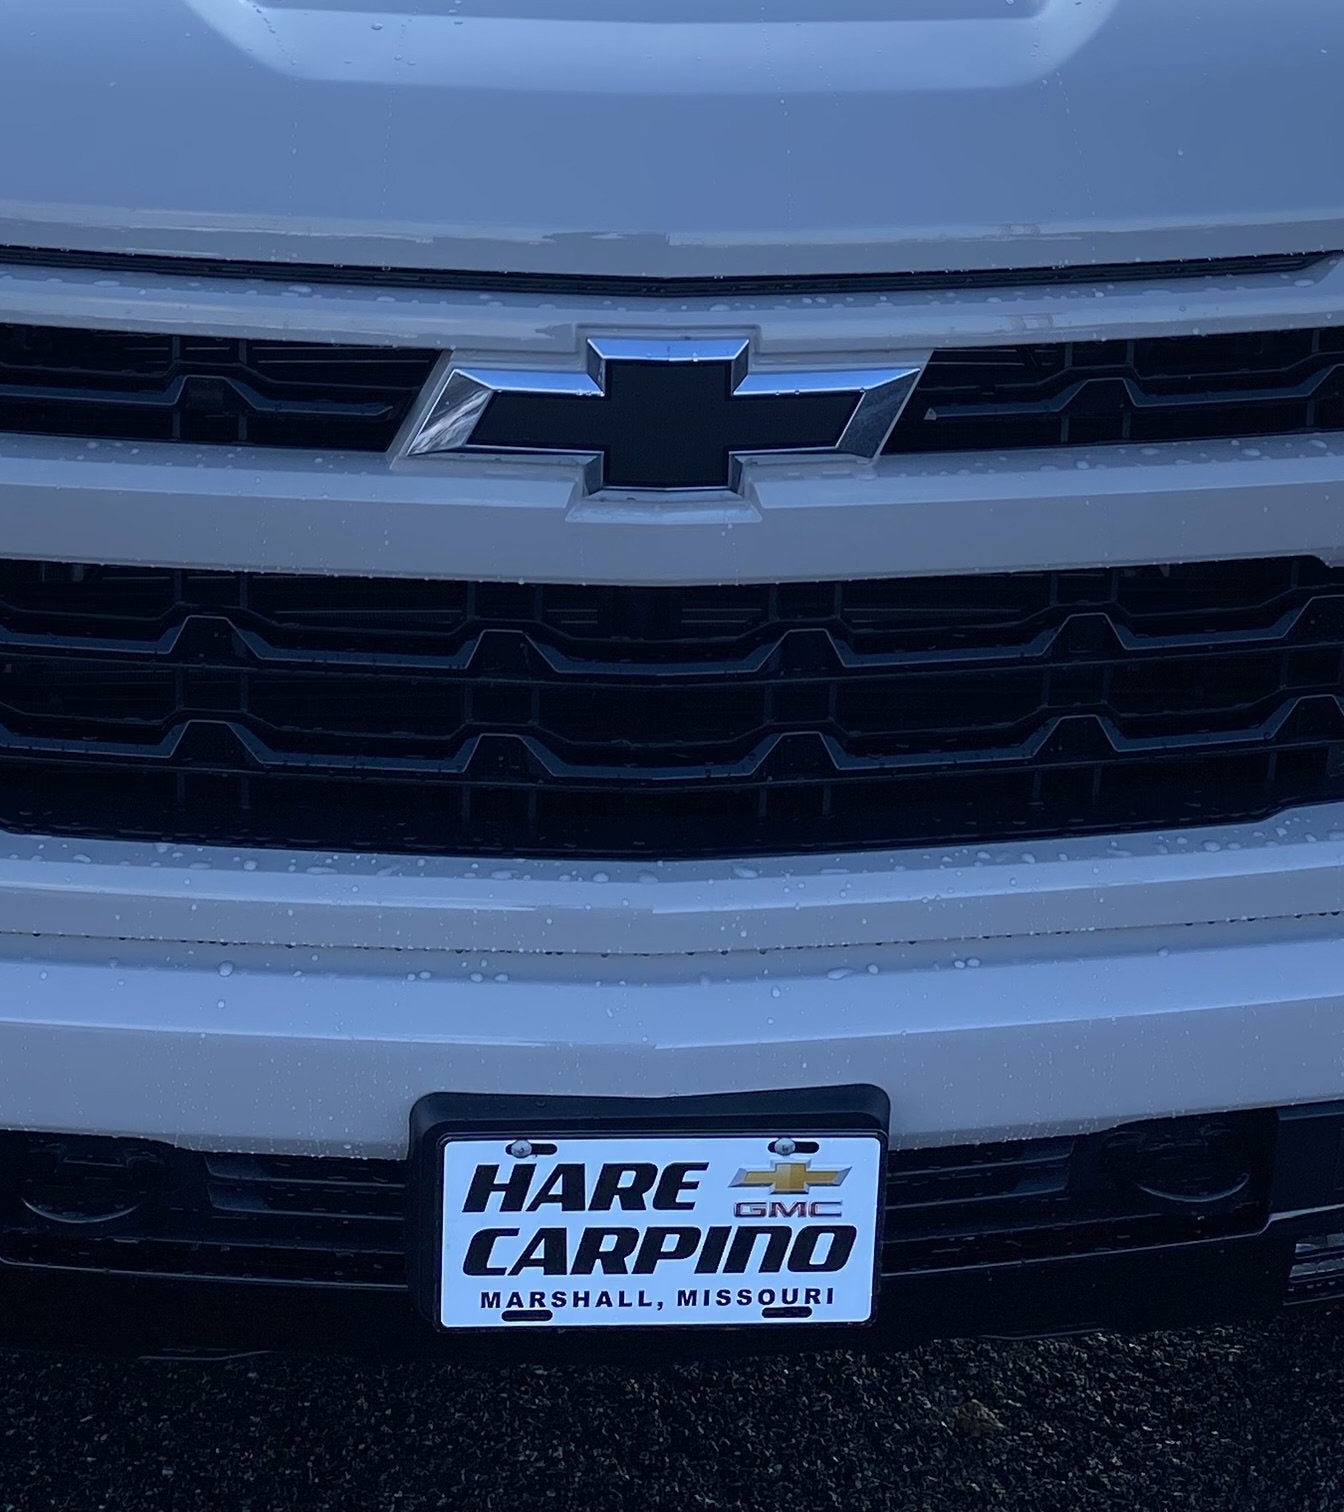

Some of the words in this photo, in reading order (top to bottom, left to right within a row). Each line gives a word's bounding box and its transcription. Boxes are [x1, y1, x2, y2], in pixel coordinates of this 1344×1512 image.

[462, 1162, 709, 1213] HARE
[733, 1199, 844, 1218] GMC
[462, 1225, 858, 1277] CARPINO
[480, 1289, 665, 1311] MARSHALL,
[677, 1287, 835, 1307] MISSOURI
